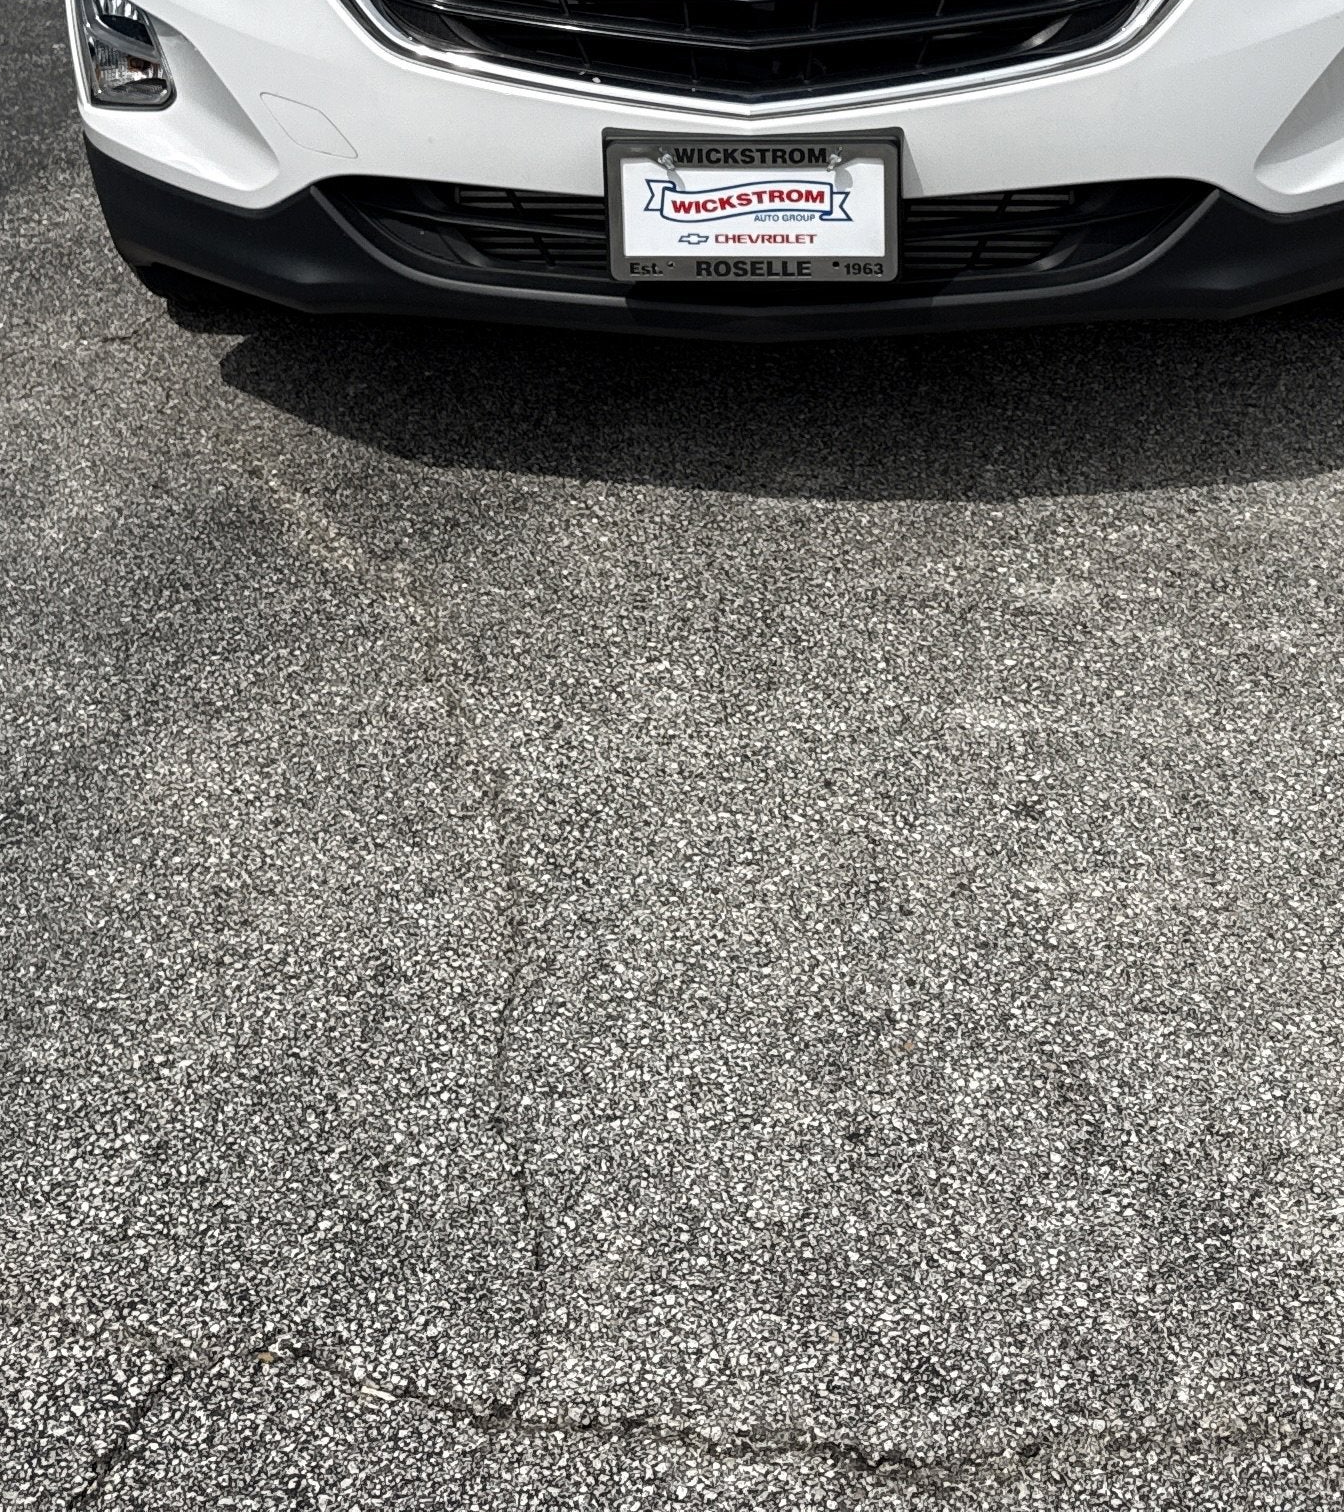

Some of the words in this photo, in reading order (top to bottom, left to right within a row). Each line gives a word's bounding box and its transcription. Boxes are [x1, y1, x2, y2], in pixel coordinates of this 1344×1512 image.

[674, 148, 827, 165] WICKSTROM
[671, 189, 825, 214] WICKSTROM
[754, 214, 779, 222] AUTO
[782, 214, 816, 222] GROUP
[714, 233, 817, 244] CHEVROLET
[629, 262, 663, 275] Est.
[696, 260, 812, 277] ROSELLE
[844, 262, 884, 276] 1963
